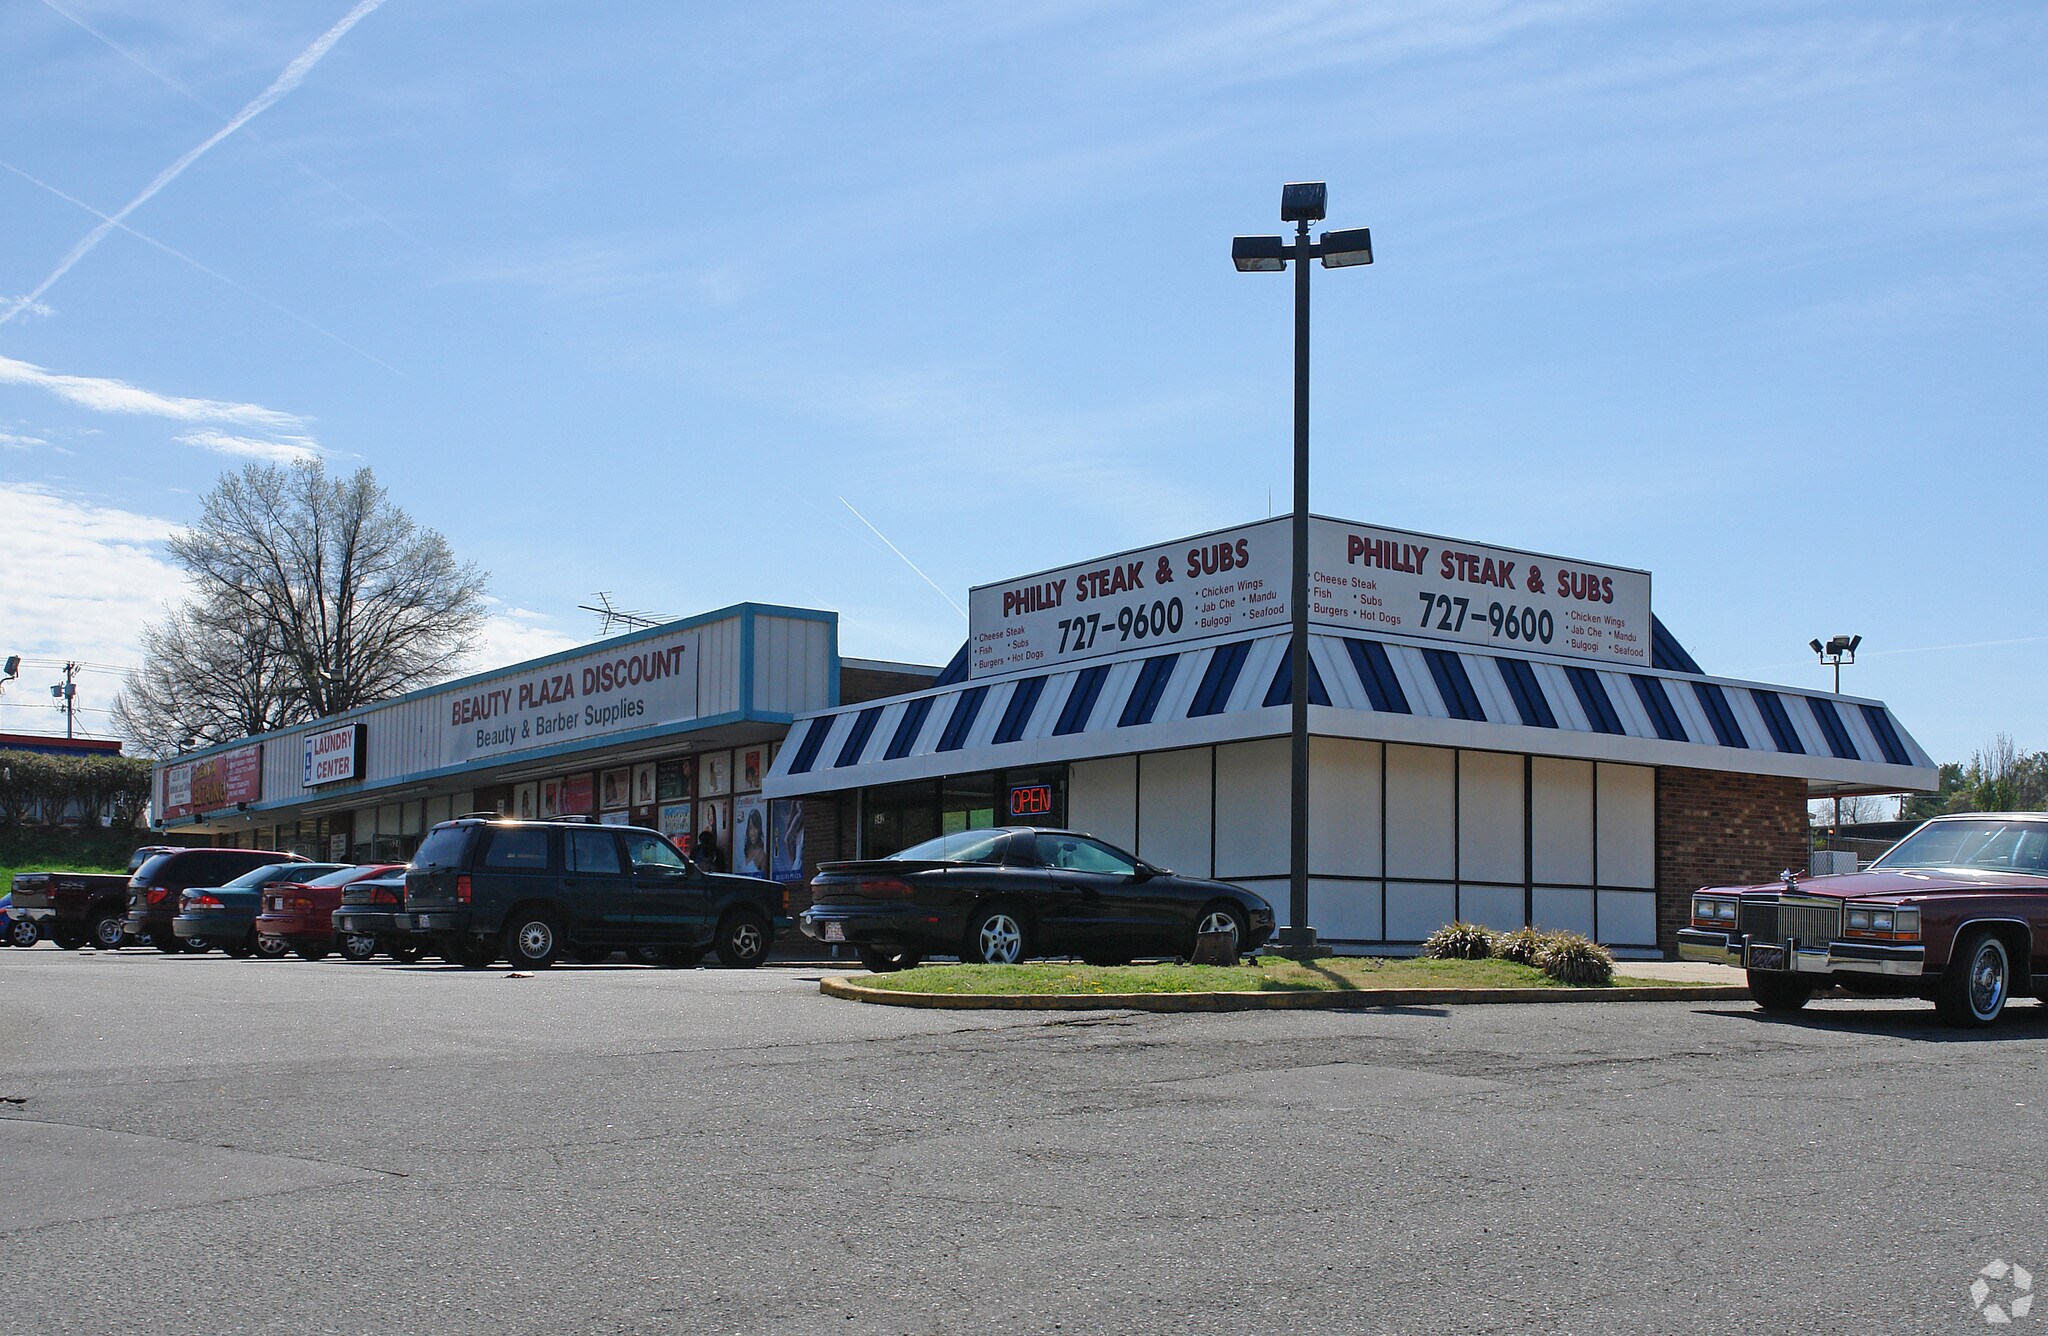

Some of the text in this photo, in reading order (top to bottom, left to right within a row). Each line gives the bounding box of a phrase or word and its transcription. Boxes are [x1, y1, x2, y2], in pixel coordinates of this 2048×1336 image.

[1348, 534, 1614, 604] PHILLY STEAK & SUBS
[1003, 538, 1249, 618] PHILLY STEAK & SUBS
[1314, 571, 1377, 591] Cheese Steak
[1201, 578, 1263, 599] Chicken Wings
[1314, 587, 1332, 600] Fish
[1201, 597, 1235, 613] Jab Che
[1249, 590, 1277, 604] Mandu
[1360, 594, 1383, 607] Subs
[1249, 604, 1285, 620] Seafood
[1314, 602, 1348, 618] Burgers
[1360, 608, 1401, 626] Hot Dogs
[1419, 591, 1554, 645] 727-9600
[1058, 596, 1183, 654] 727-9600
[1201, 614, 1232, 629] Bulgogi
[1571, 610, 1625, 629] Chicken Wings
[979, 626, 1025, 643] Cheese Steak
[1571, 625, 1602, 638] Jab Che
[1614, 630, 1637, 643] Mandu
[979, 645, 993, 656] Fish
[1012, 638, 1029, 650] Subs
[1571, 639, 1599, 653] Bulgogi
[1614, 644, 1644, 658] Seafood
[979, 656, 1004, 670] Burgers
[1012, 649, 1044, 663] Hot Dogs
[452, 644, 686, 727] BEAUTY PLAZA DISCOUNT
[476, 699, 644, 749] Beauty & Barber Supplies
[314, 730, 353, 756] LAUNDRY
[317, 756, 350, 779] CENTER
[1012, 786, 1050, 815] OPEN
